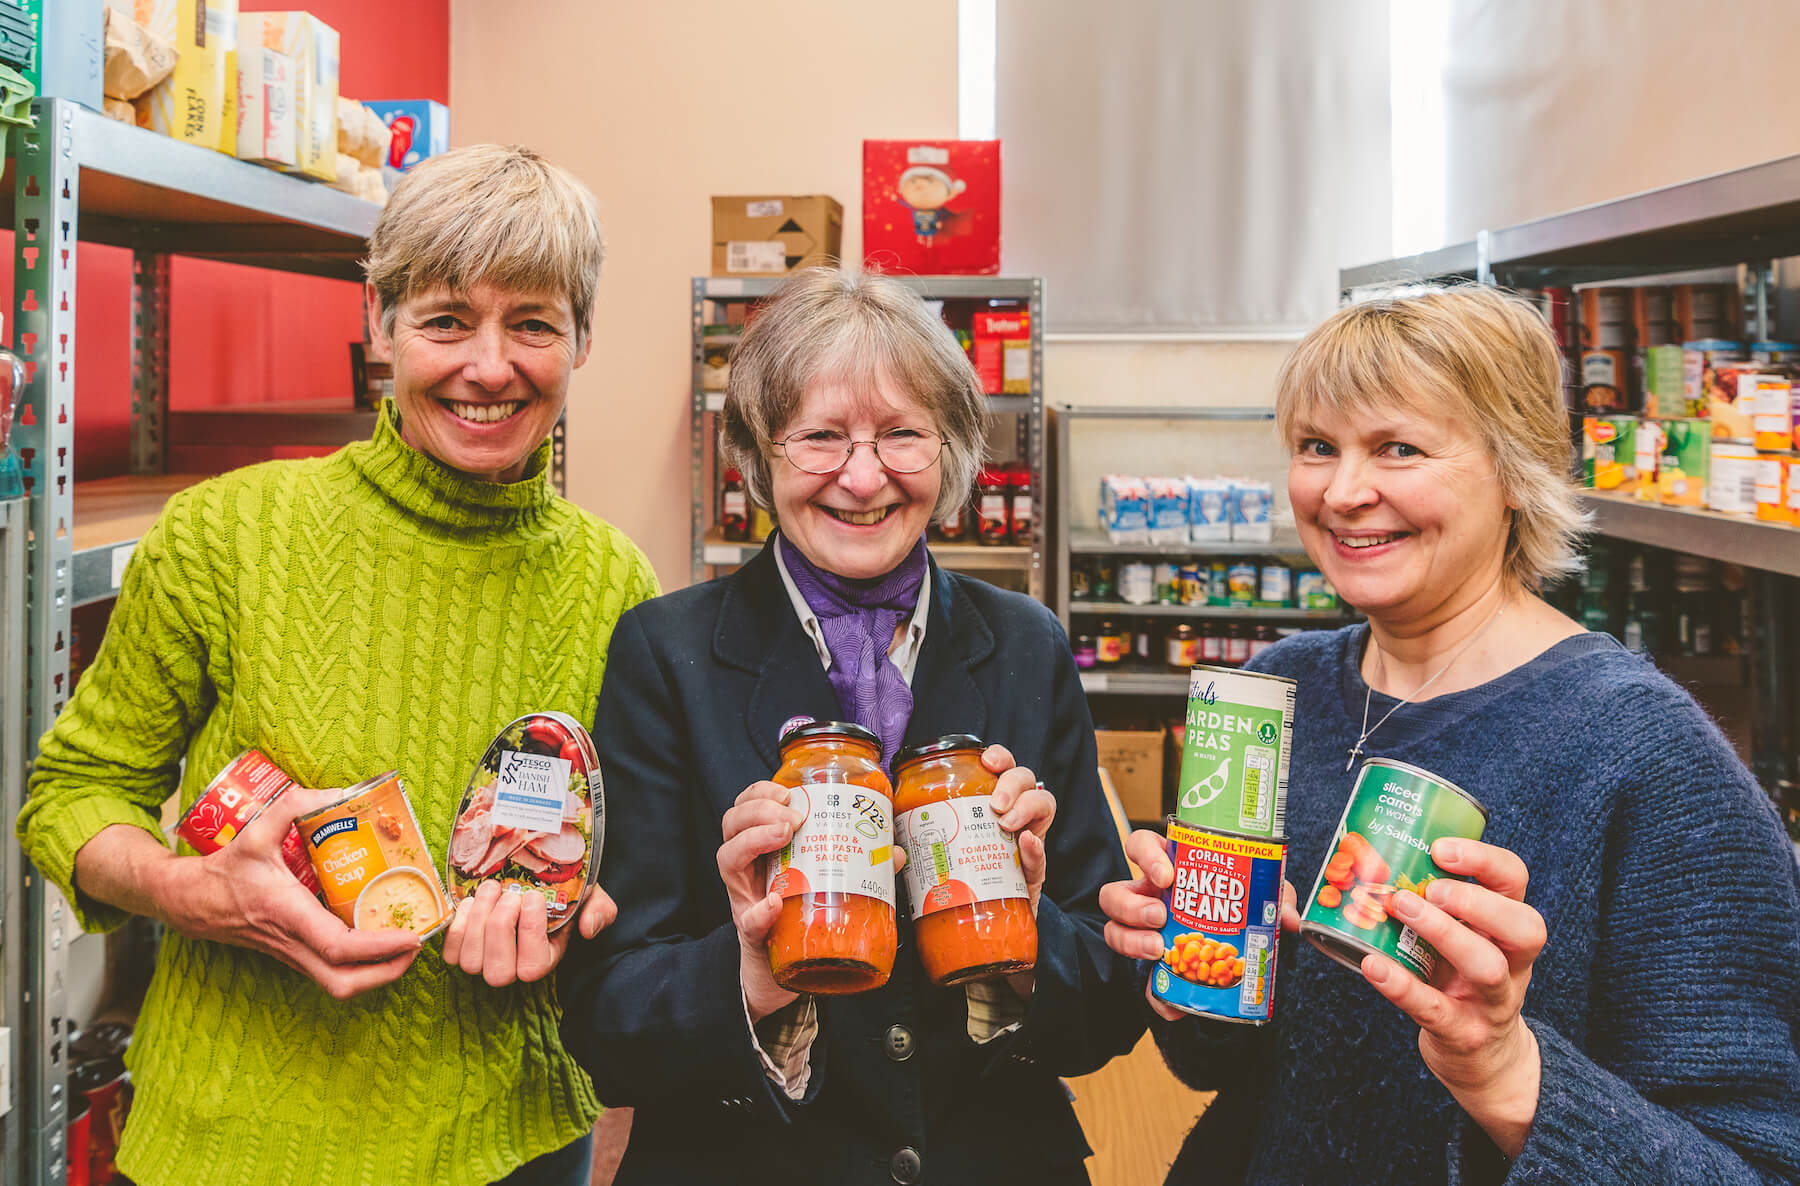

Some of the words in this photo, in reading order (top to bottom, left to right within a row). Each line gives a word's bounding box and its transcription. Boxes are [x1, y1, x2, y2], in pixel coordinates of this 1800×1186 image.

[184, 87, 197, 137] FLAKES
[196, 98, 206, 133] CORN
[1188, 729, 1232, 751] PEAS
[1265, 726, 1271, 738] 1
[522, 758, 551, 768] TESCO
[518, 780, 547, 794] HAM
[519, 772, 550, 783] DANISH
[1382, 782, 1422, 803] sliced
[852, 794, 885, 830] 8/23
[1375, 803, 1384, 814] in
[1386, 808, 1416, 825] water
[1378, 795, 1423, 816] carrots
[814, 812, 852, 820] HONEST
[313, 819, 354, 844] BRAMWELLS
[964, 822, 995, 831] HONEST
[1368, 818, 1384, 835] by
[1384, 823, 1431, 855] Sainsbu
[805, 834, 849, 843] TOMATO
[852, 836, 859, 844] &
[961, 843, 998, 855] TOMATO
[1212, 840, 1274, 857] MULTIPACK
[323, 846, 368, 873] Chicken
[800, 844, 829, 854] BASIL
[832, 844, 863, 855] PASTA
[815, 854, 849, 863] SAUCE
[958, 854, 986, 865] BASIL
[987, 852, 1011, 861] PASTA
[1188, 849, 1235, 870] CORALE
[336, 866, 365, 886] Soup
[974, 862, 1004, 872] SAUCE
[1179, 860, 1209, 870] PREMIUM
[1212, 865, 1247, 880] QUALITY
[1176, 868, 1245, 901] BAKED
[1174, 888, 1243, 924] BEANS
[1182, 918, 1193, 926] RICH
[1195, 922, 1218, 931] TOMATO
